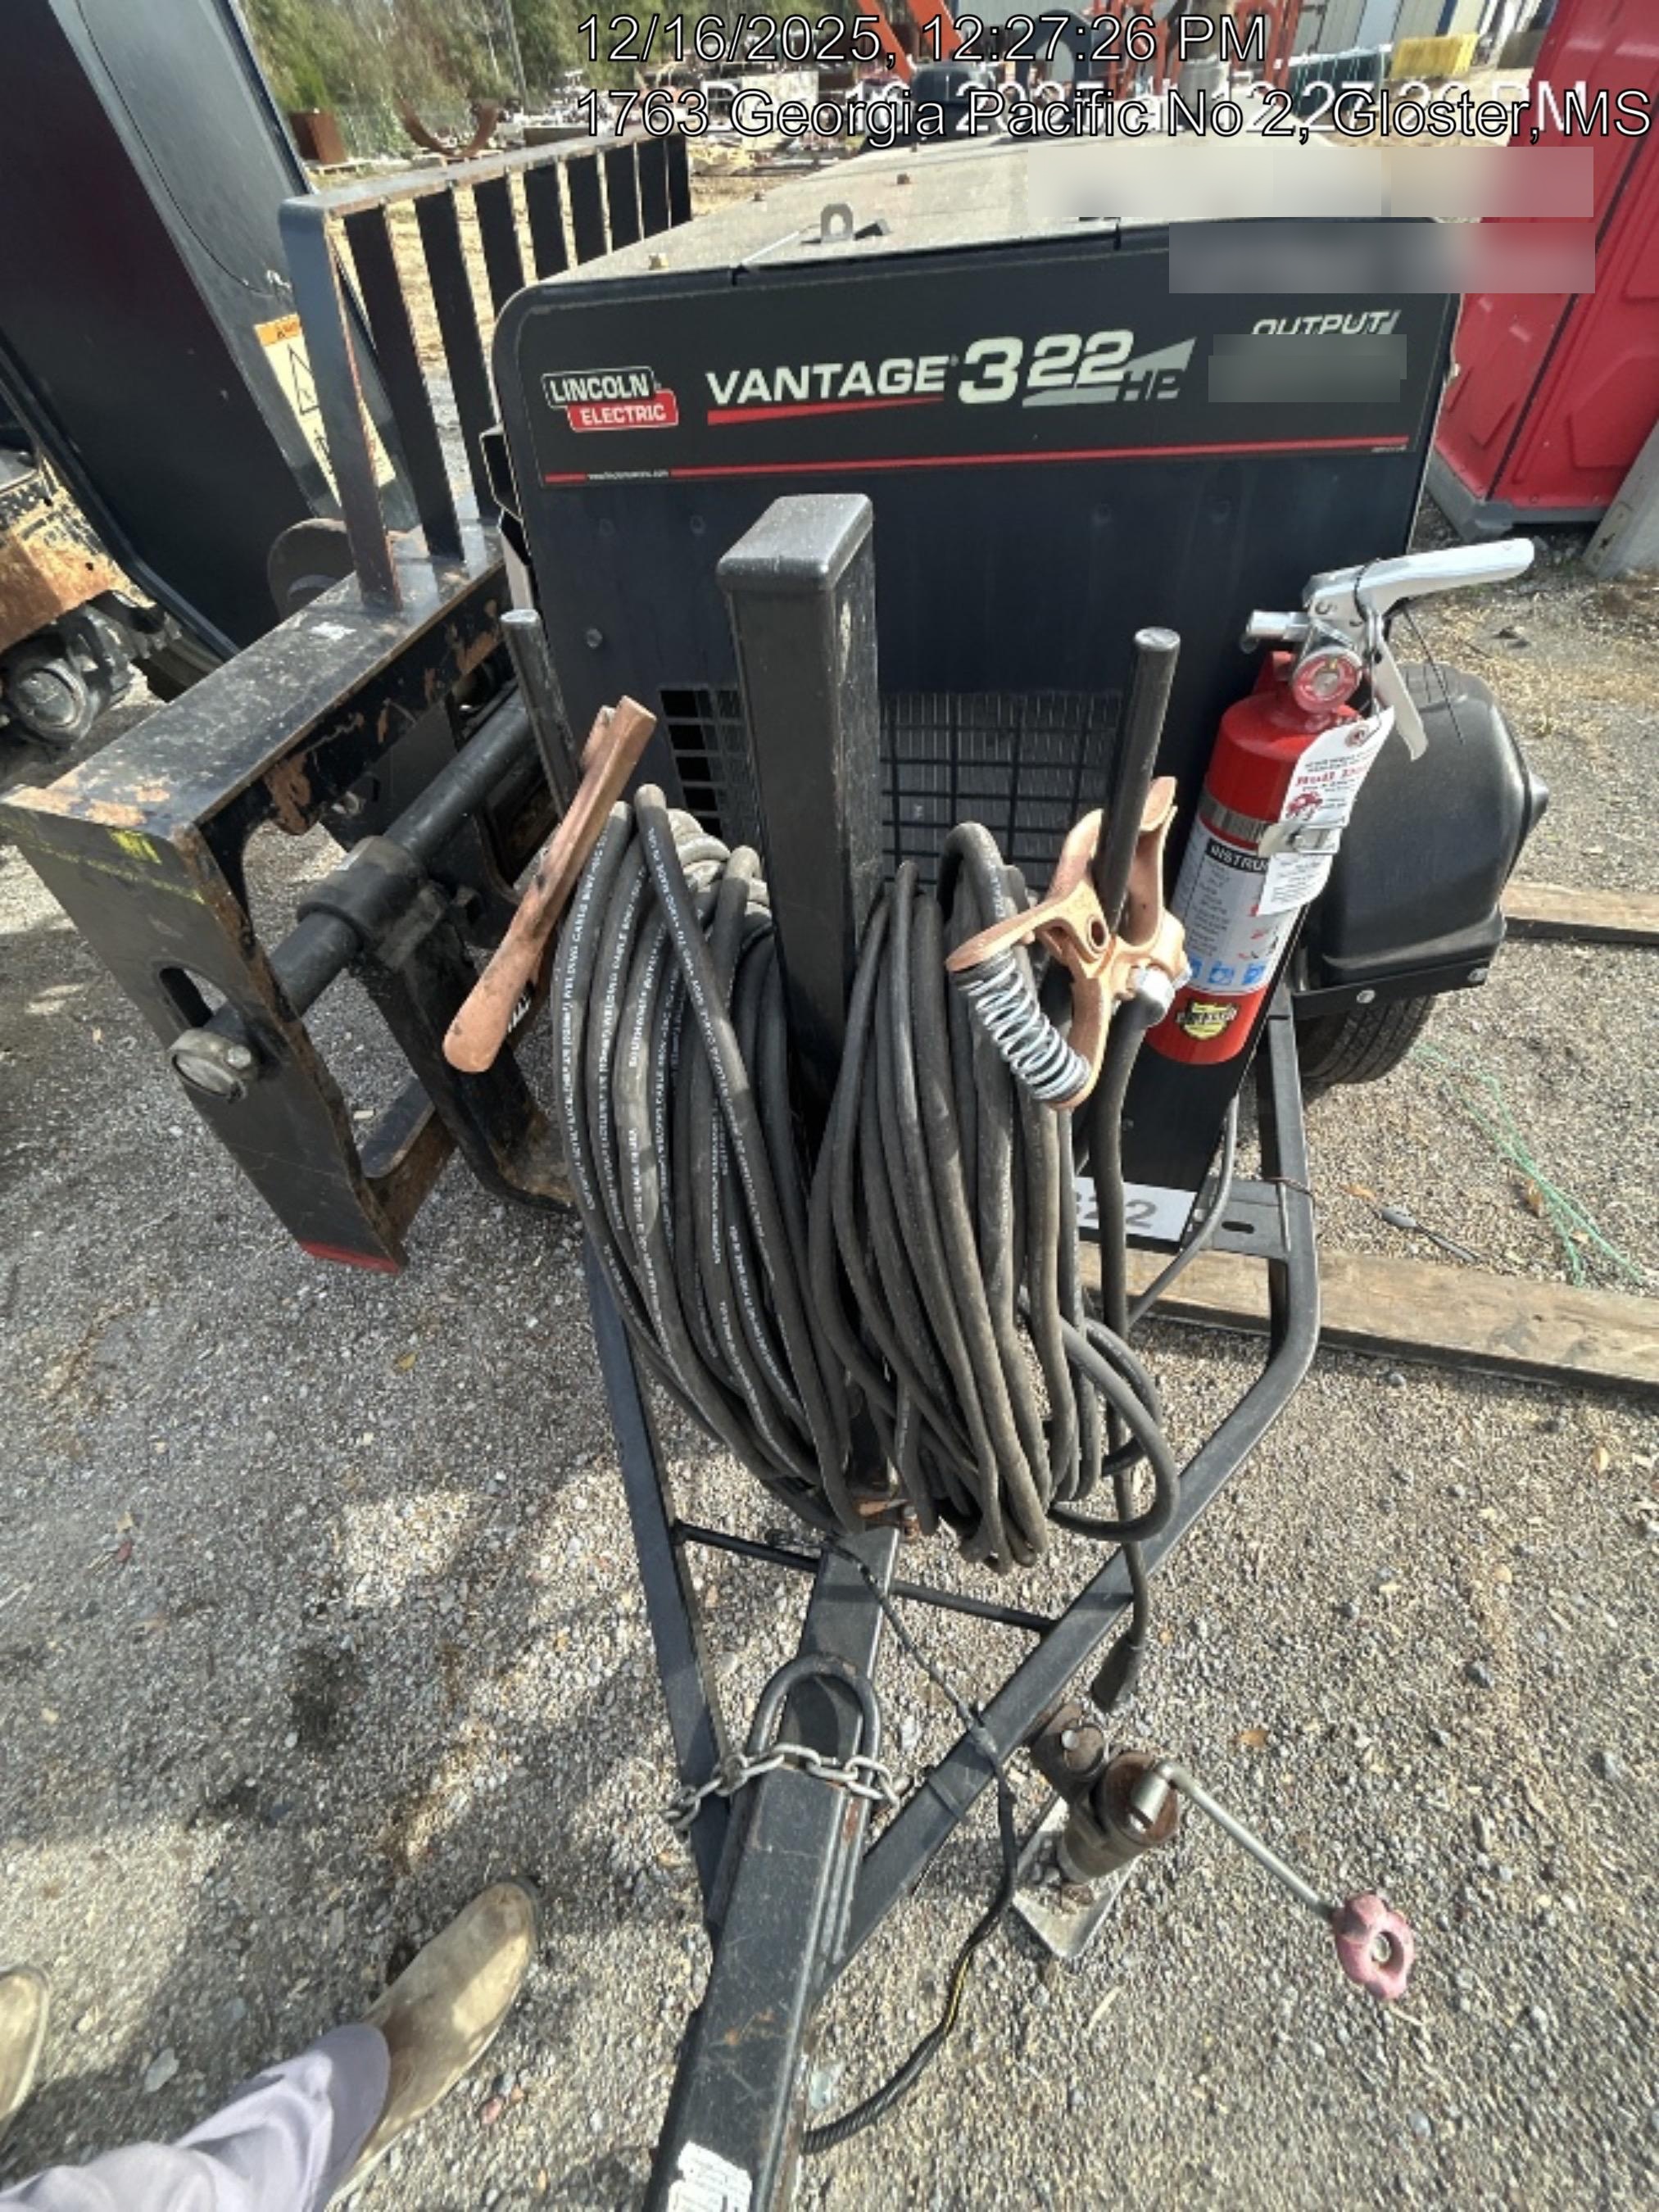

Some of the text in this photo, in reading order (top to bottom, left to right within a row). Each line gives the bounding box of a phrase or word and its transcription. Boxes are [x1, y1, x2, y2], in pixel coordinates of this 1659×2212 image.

[1251, 310, 1391, 335] OUTPUT
[705, 355, 950, 405] VANTAGE
[959, 329, 1134, 404] 322
[550, 373, 650, 404] LINCOLN
[581, 404, 667, 426] ELECTRIC
